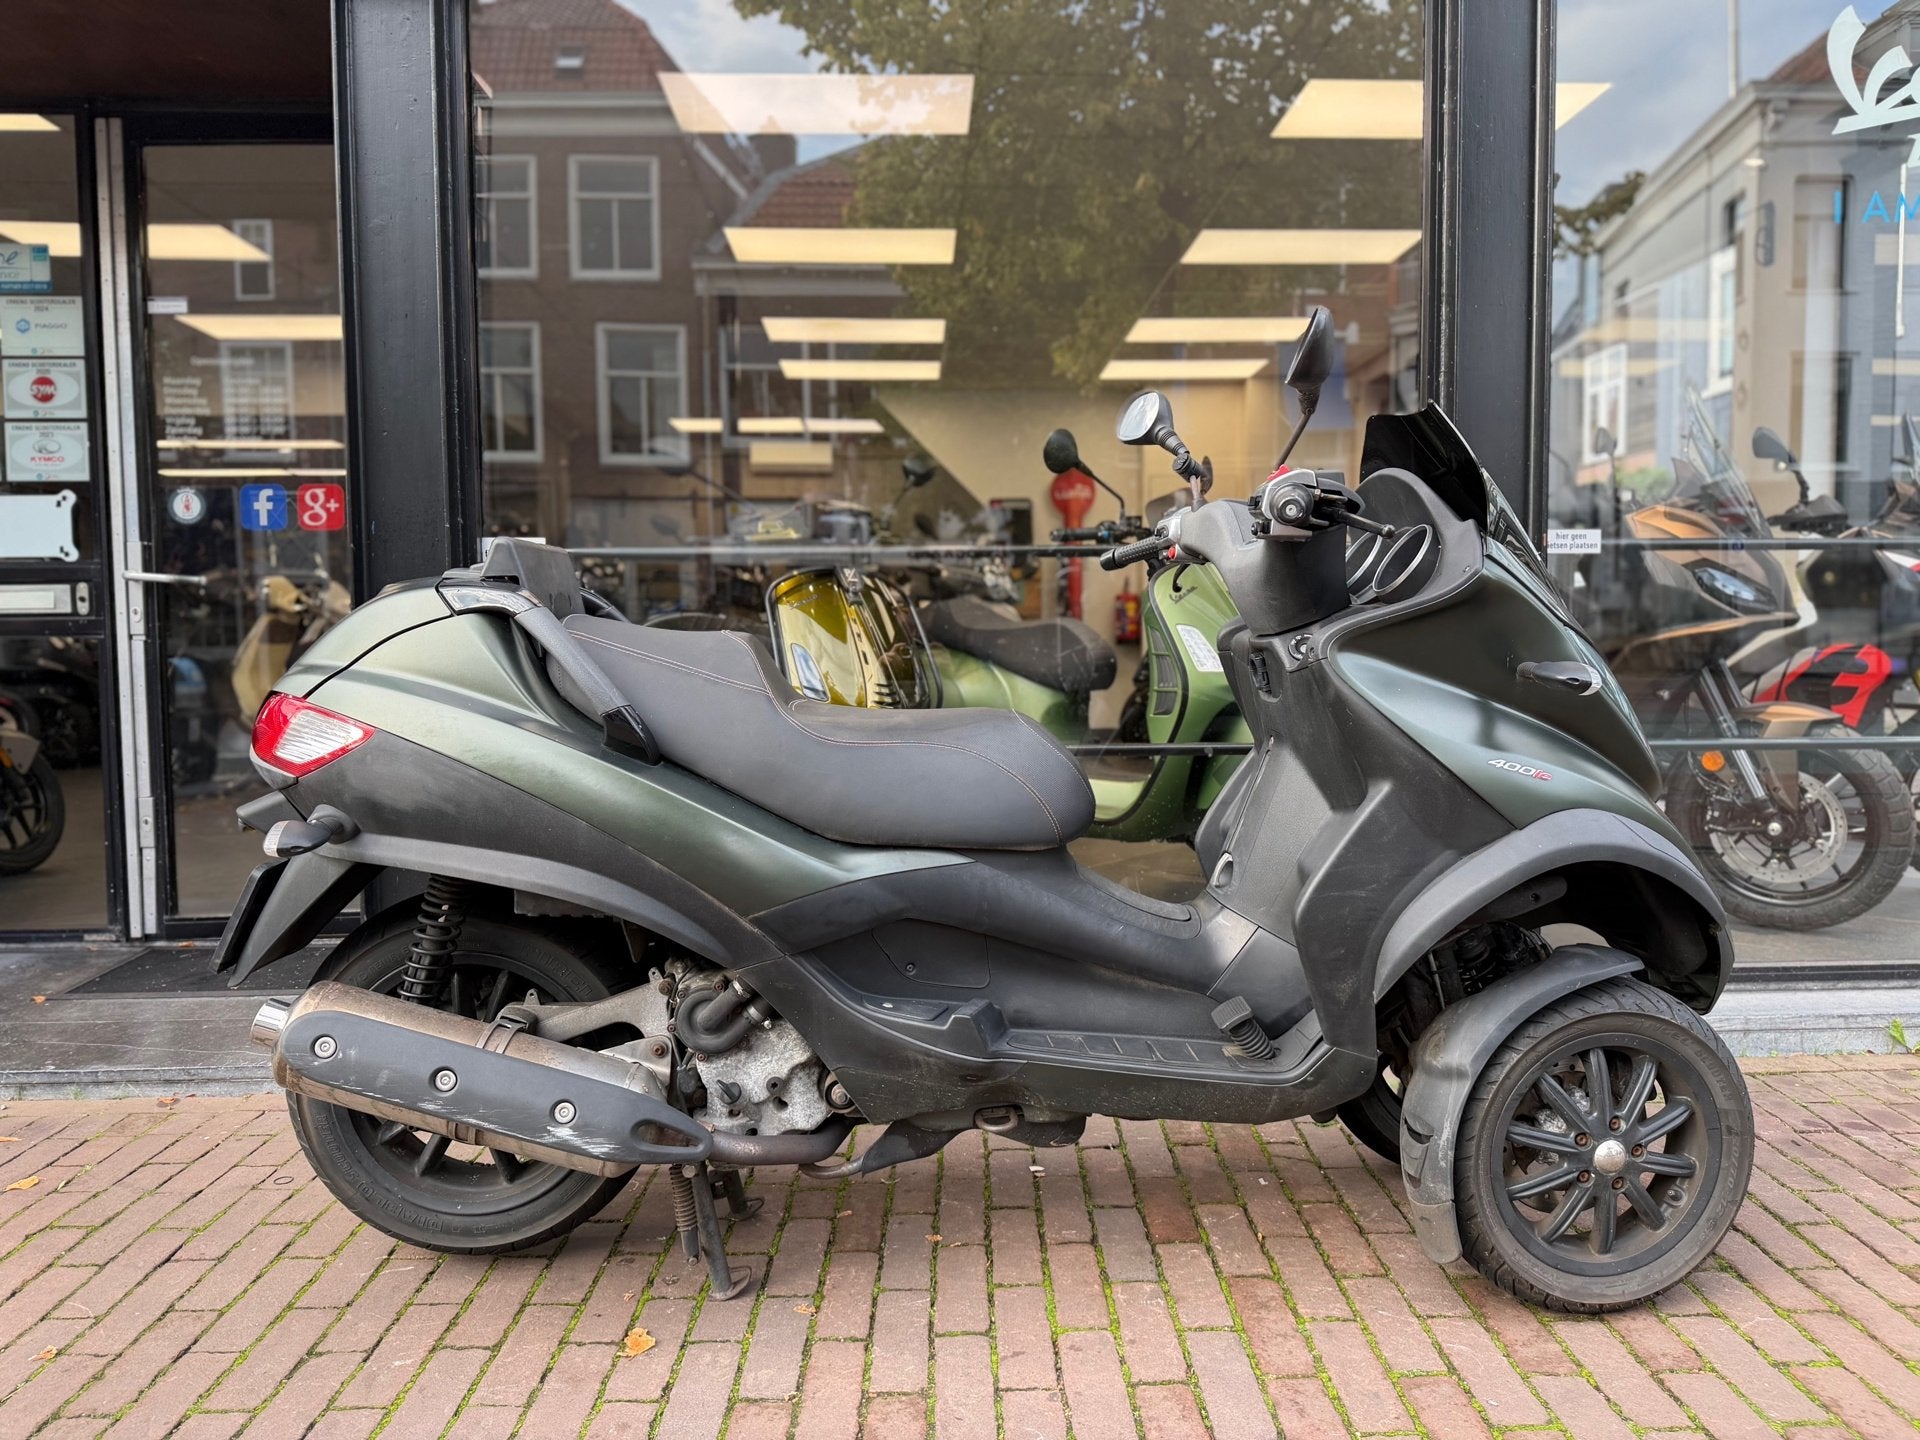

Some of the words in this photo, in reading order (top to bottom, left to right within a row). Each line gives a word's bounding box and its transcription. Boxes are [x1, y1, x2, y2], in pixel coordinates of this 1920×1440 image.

[30, 383, 57, 396] SYM
[1555, 532, 1569, 540] hier
[1570, 533, 1587, 541] geen
[1569, 542, 1598, 551] plaatsen
